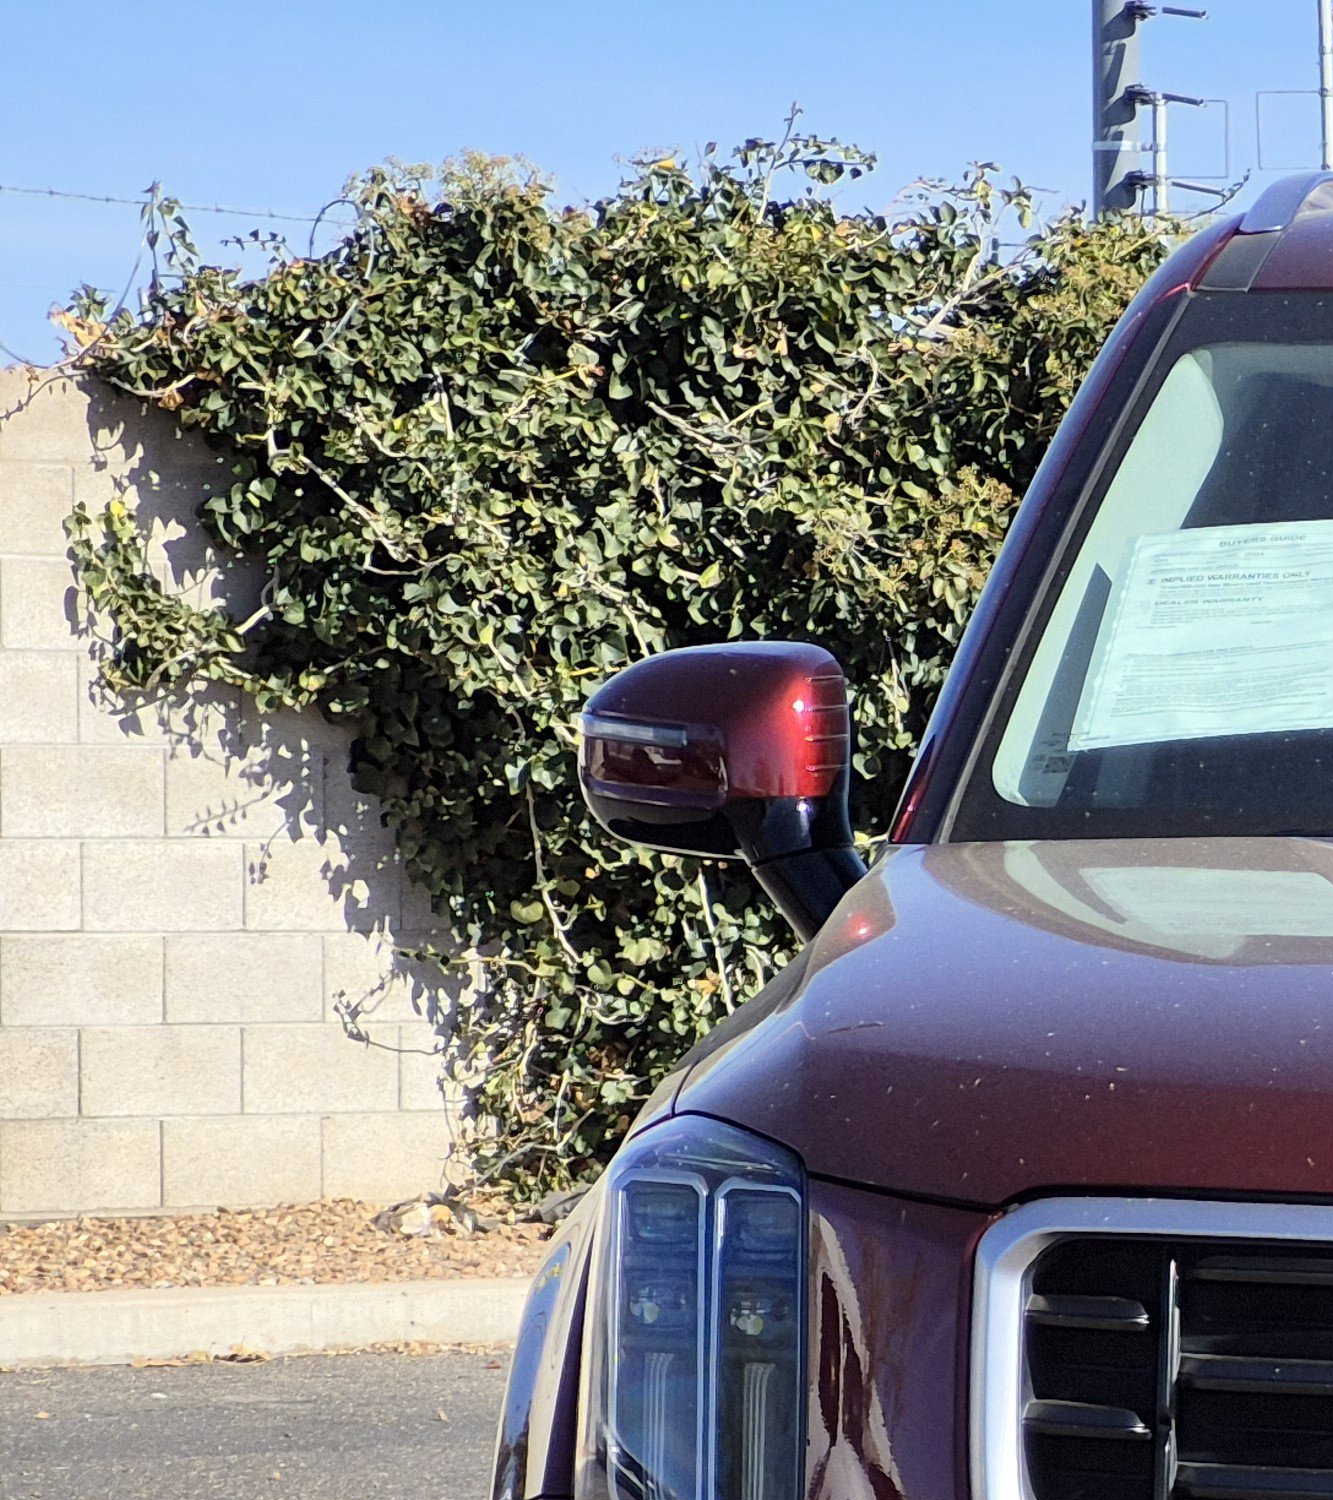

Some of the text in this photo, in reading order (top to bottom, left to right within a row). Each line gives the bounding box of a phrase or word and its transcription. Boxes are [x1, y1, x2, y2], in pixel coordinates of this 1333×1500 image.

[1219, 536, 1266, 548] BUYERS
[1160, 574, 1204, 584] IMPLIED
[1207, 572, 1280, 582] WARRANTIES
[1282, 570, 1312, 580] ONLY
